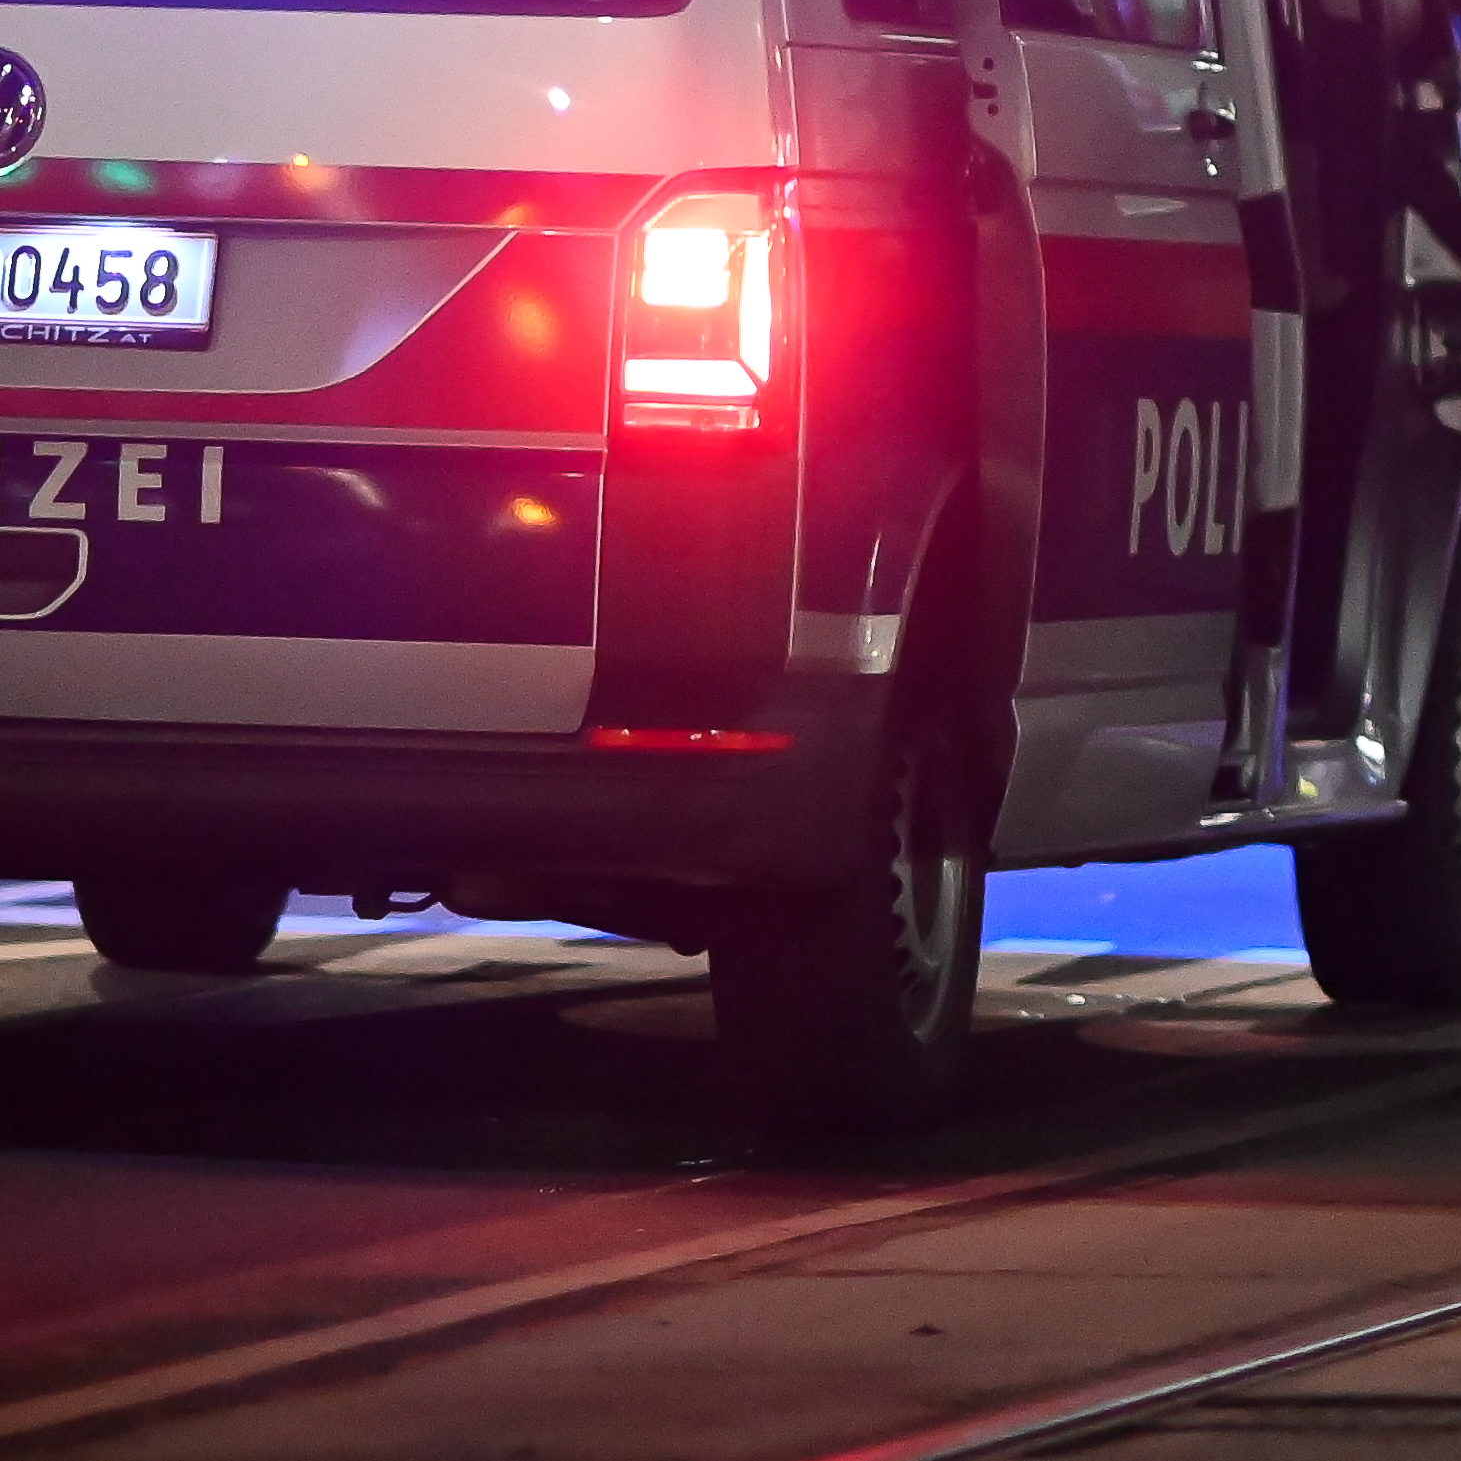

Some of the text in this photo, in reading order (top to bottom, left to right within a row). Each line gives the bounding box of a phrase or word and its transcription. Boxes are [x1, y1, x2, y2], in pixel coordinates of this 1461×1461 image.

[4, 245, 180, 316] 0458
[28, 441, 224, 524] ZEI
[1129, 397, 1249, 557] POLI
